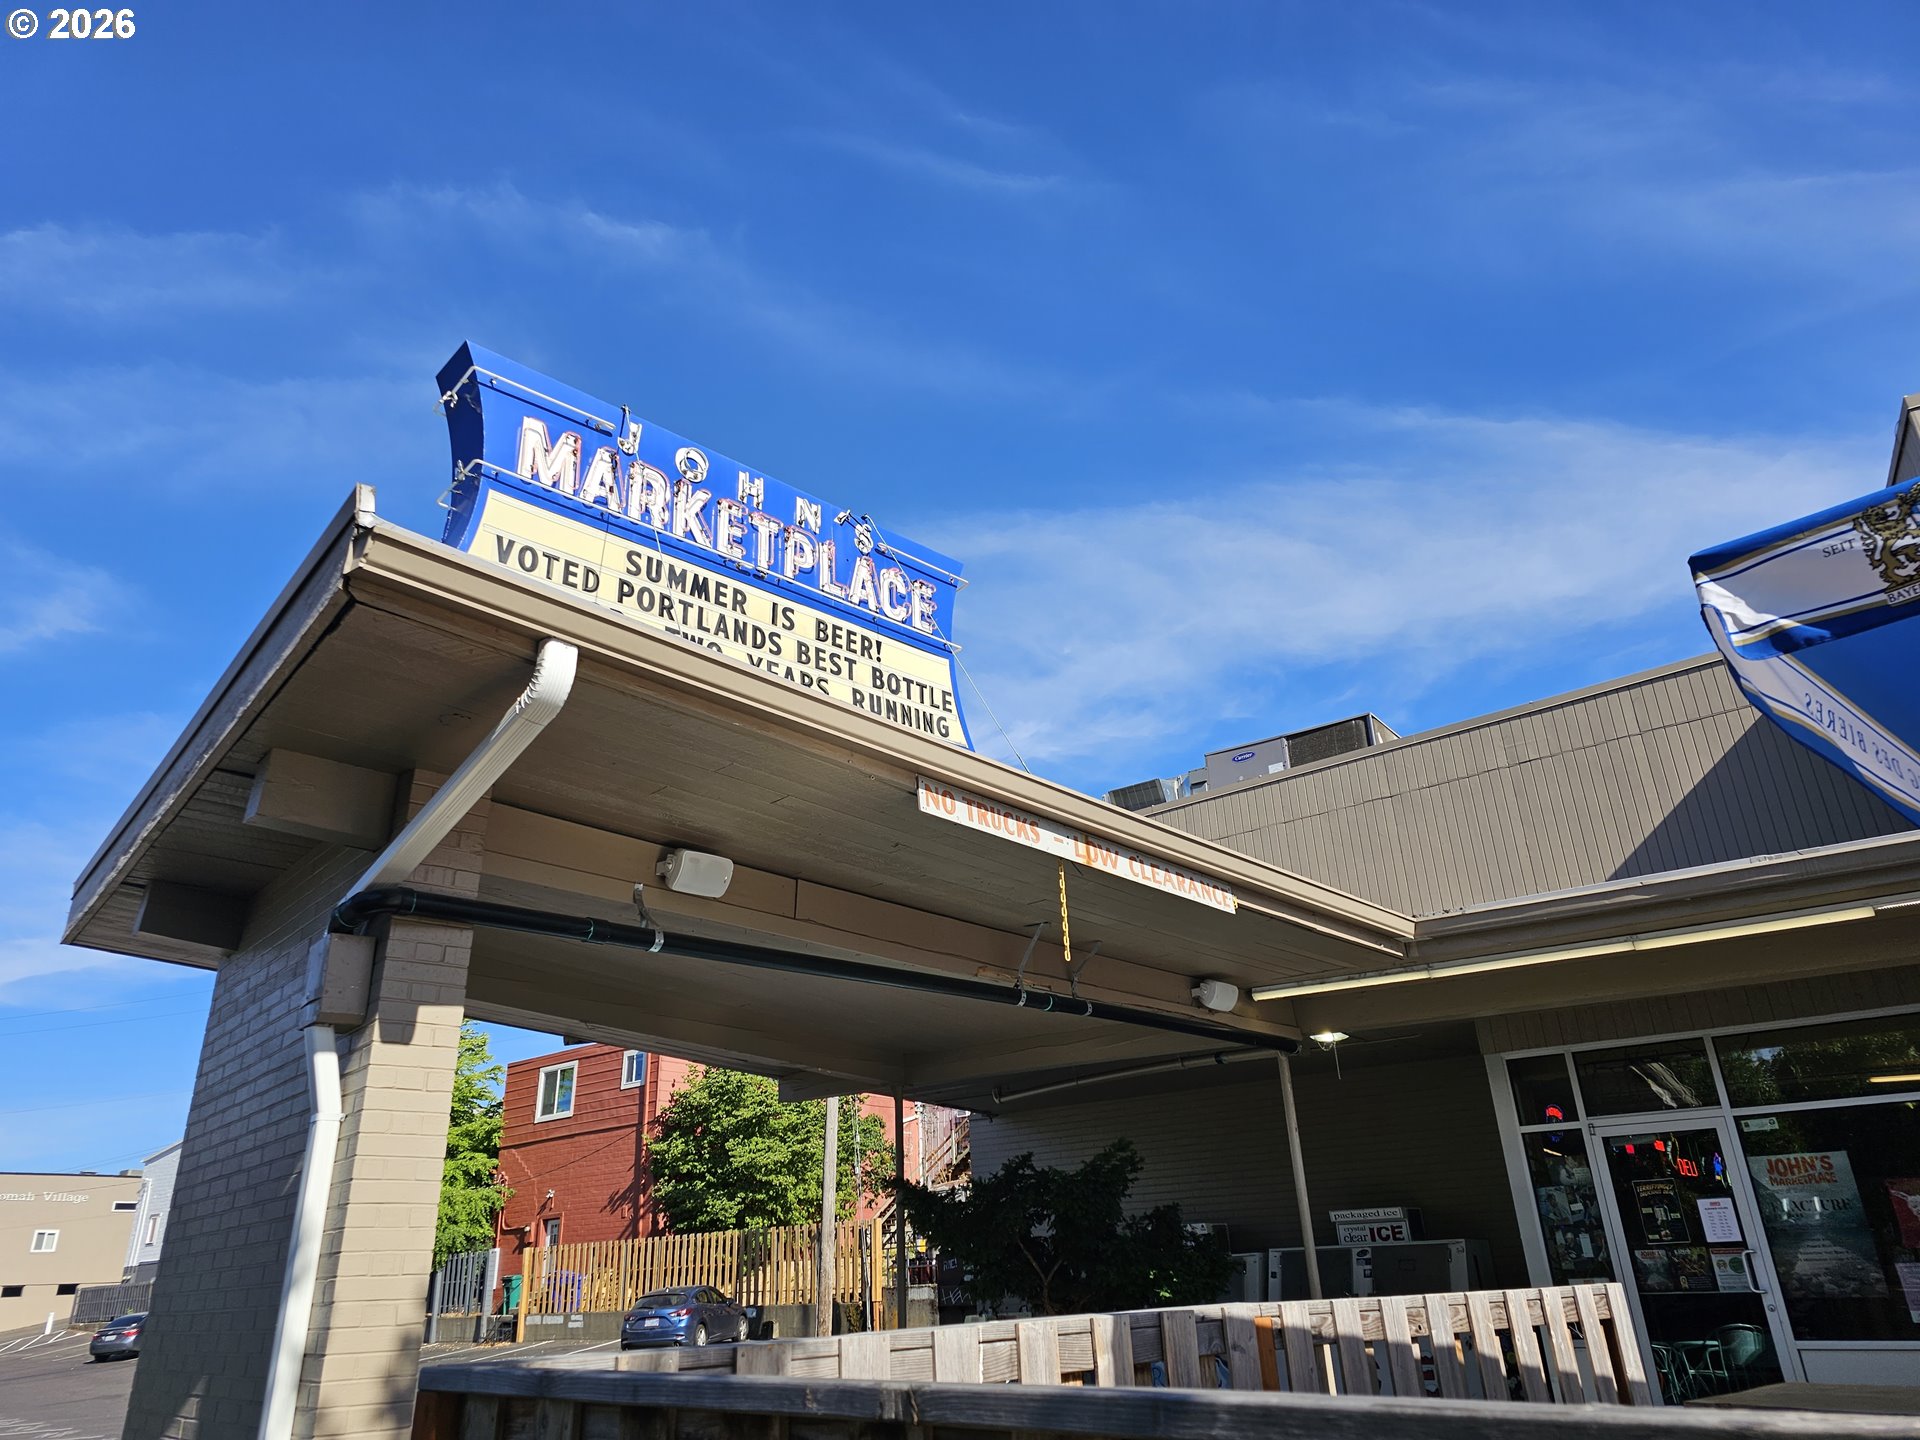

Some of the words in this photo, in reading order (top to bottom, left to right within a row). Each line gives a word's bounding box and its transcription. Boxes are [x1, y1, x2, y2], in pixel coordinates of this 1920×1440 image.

[517, 416, 937, 634] MARKETPLACE
[1822, 538, 1856, 558] SEIT
[1887, 584, 1920, 603] BAYE
[626, 550, 747, 615] SUMMER
[771, 602, 795, 631] IS
[815, 618, 882, 662] BEER!
[496, 534, 600, 592] VOTED
[618, 578, 782, 655] PORTLANDS
[797, 640, 857, 681] BEST
[872, 666, 952, 713] BOTTLE
[852, 687, 950, 738] RUNNING
[1233, 752, 1254, 762] Carrier
[924, 783, 957, 816] NO
[961, 796, 1041, 844] TRUCKS
[1073, 835, 1120, 871] LOW
[1128, 855, 1231, 908] CLEARANCE
[1677, 1158, 1698, 1177] DELI
[1766, 1154, 1833, 1177] JOHN'S
[1768, 1171, 1838, 1186] MARKETPLACE
[43, 1191, 89, 1204] Village
[1334, 1208, 1380, 1221] packaged
[1383, 1209, 1398, 1217] ice
[1343, 1225, 1366, 1233] crystal
[1343, 1232, 1369, 1243] clear
[1369, 1225, 1405, 1242] ICE
